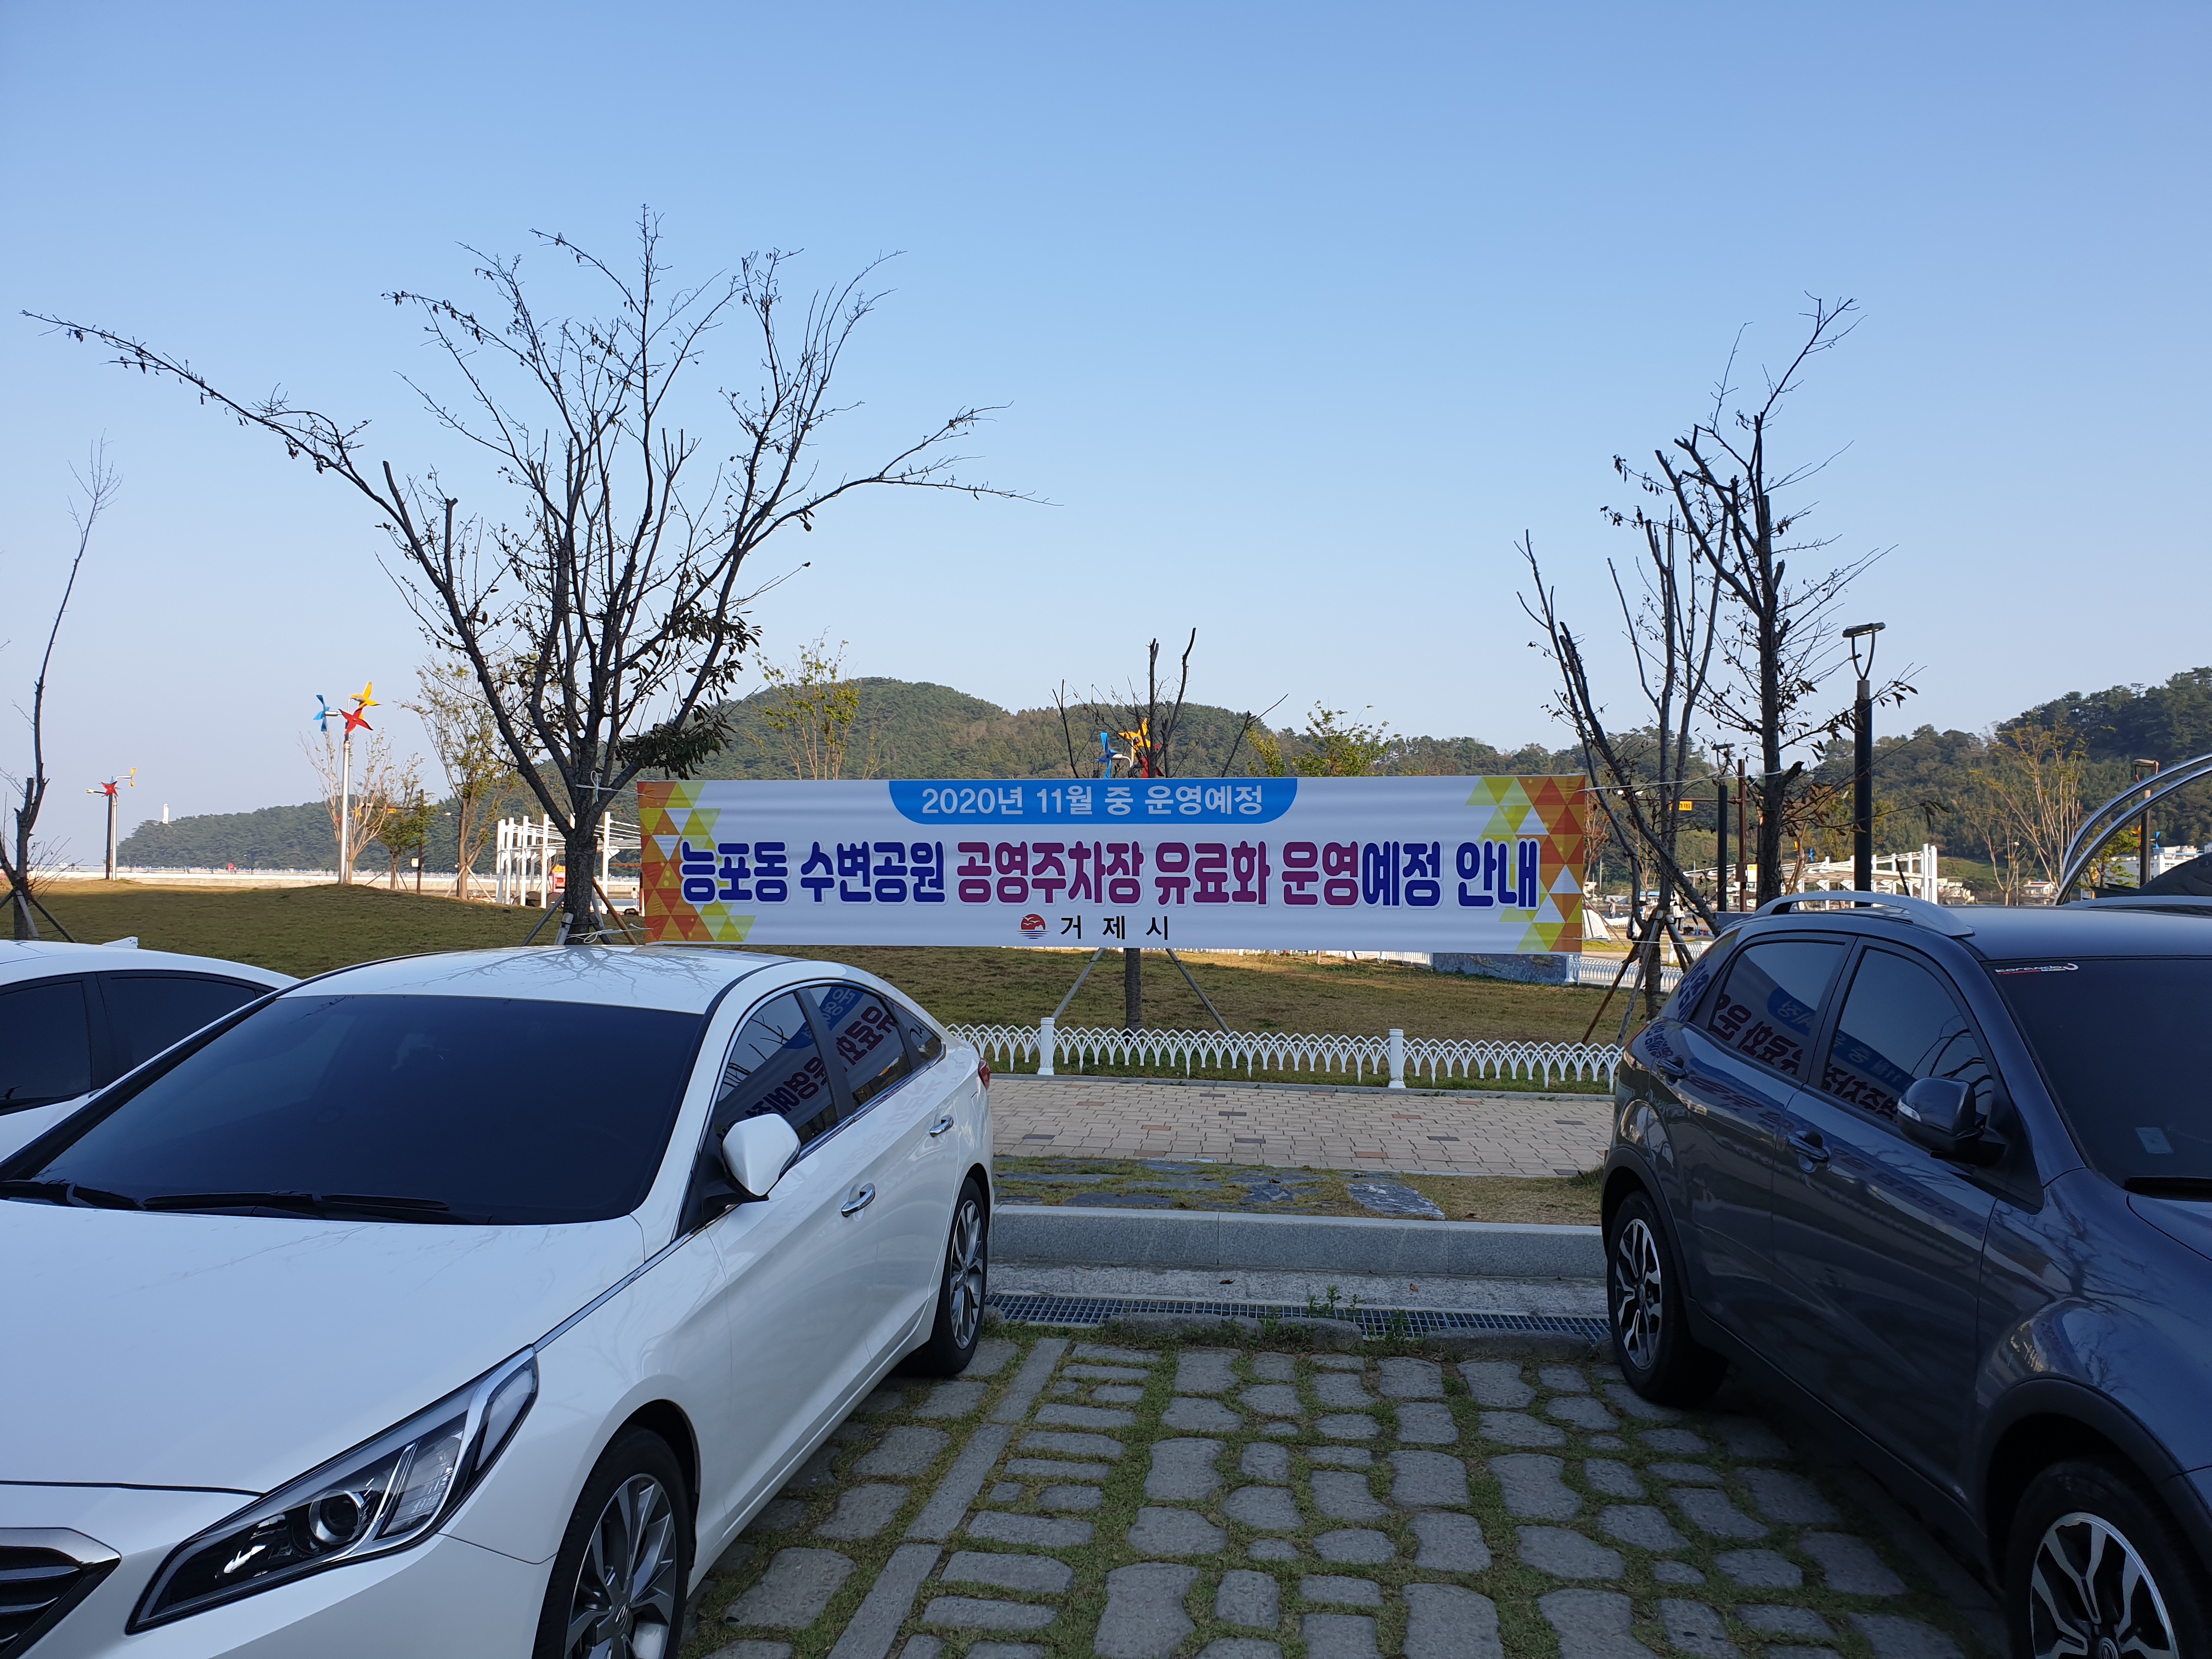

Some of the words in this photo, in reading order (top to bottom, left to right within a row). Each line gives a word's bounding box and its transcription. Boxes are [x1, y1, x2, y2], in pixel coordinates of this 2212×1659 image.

[922, 787, 1024, 815] 2020년
[1036, 786, 1093, 814] 11월
[1104, 786, 1134, 815] 중
[1144, 785, 1263, 815] 운영예정
[681, 840, 788, 904] 능포동
[800, 840, 946, 903] 수변공원
[957, 840, 1145, 904] 공영주차장
[1154, 840, 1271, 906] 유료화
[1282, 840, 1441, 907] 운영예정
[1455, 840, 1538, 909] 안내
